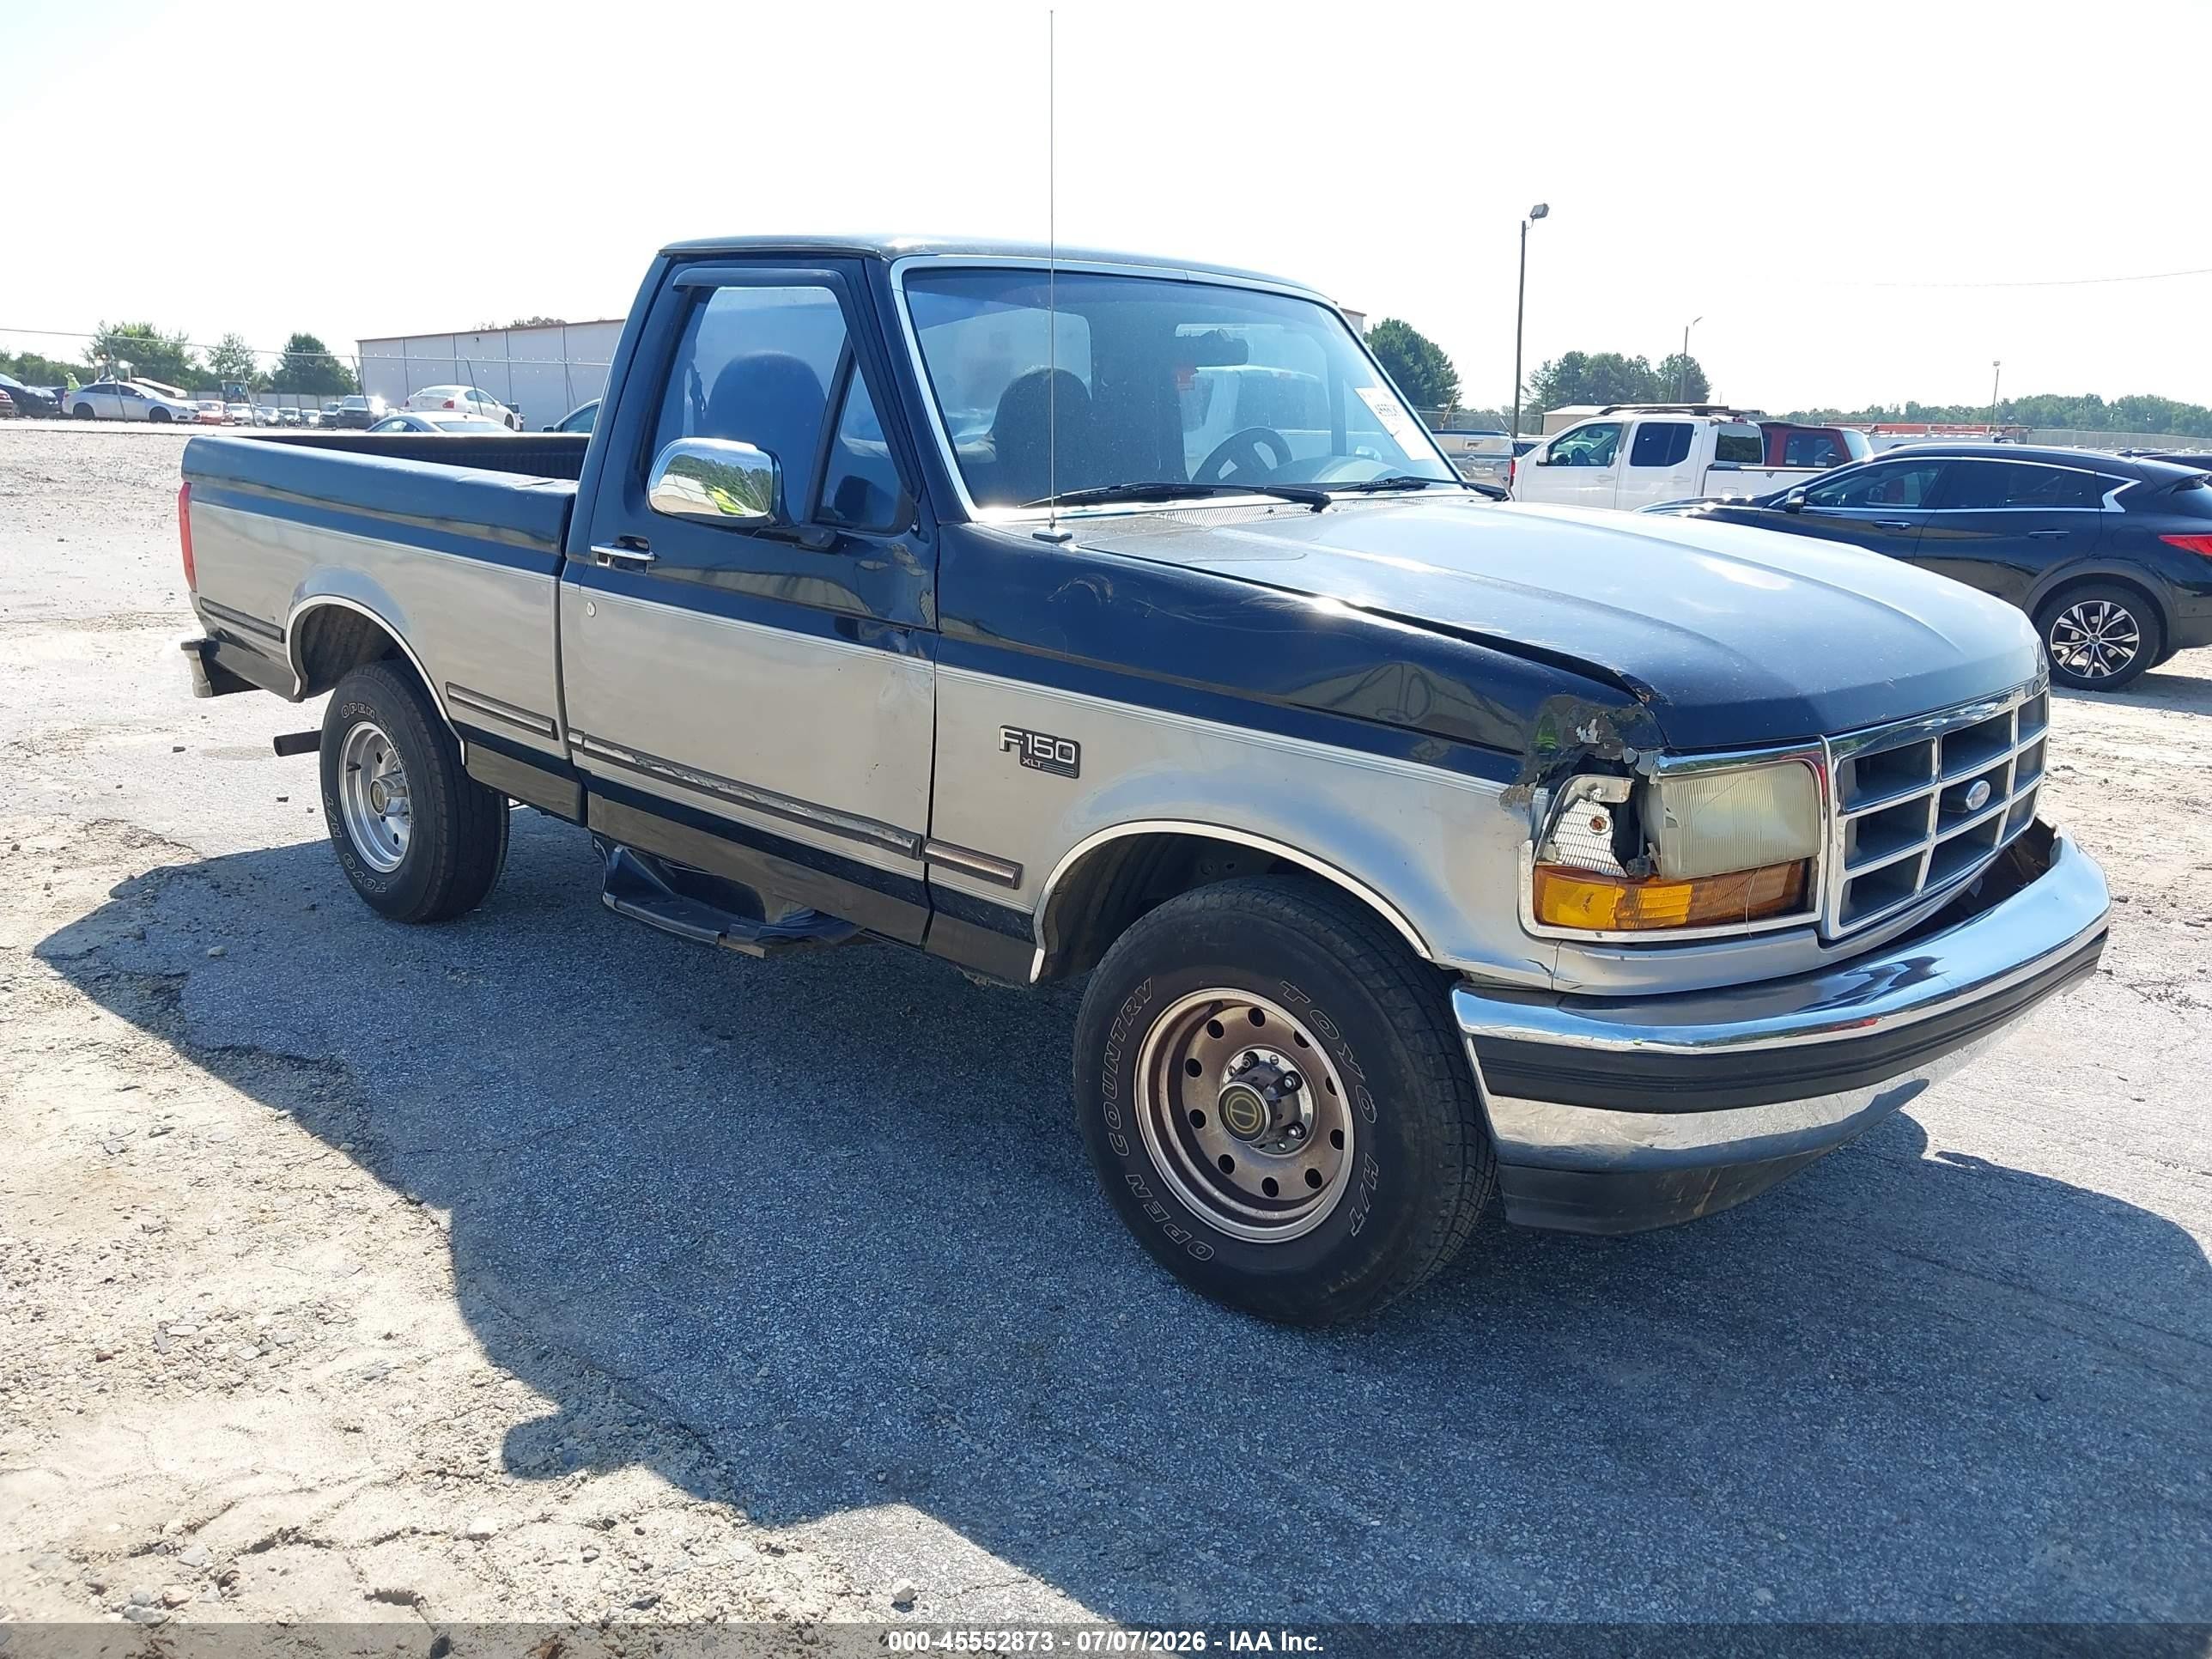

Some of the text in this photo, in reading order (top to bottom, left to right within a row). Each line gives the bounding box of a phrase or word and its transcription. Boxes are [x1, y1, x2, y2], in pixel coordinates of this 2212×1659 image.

[341, 702, 375, 719] OPEN
[1022, 757, 1044, 769] XLT
[343, 853, 387, 893] TOYO
[1102, 976, 1215, 1261] OPEN COUNTRY
[1279, 981, 1379, 1237] TOYO H/T
